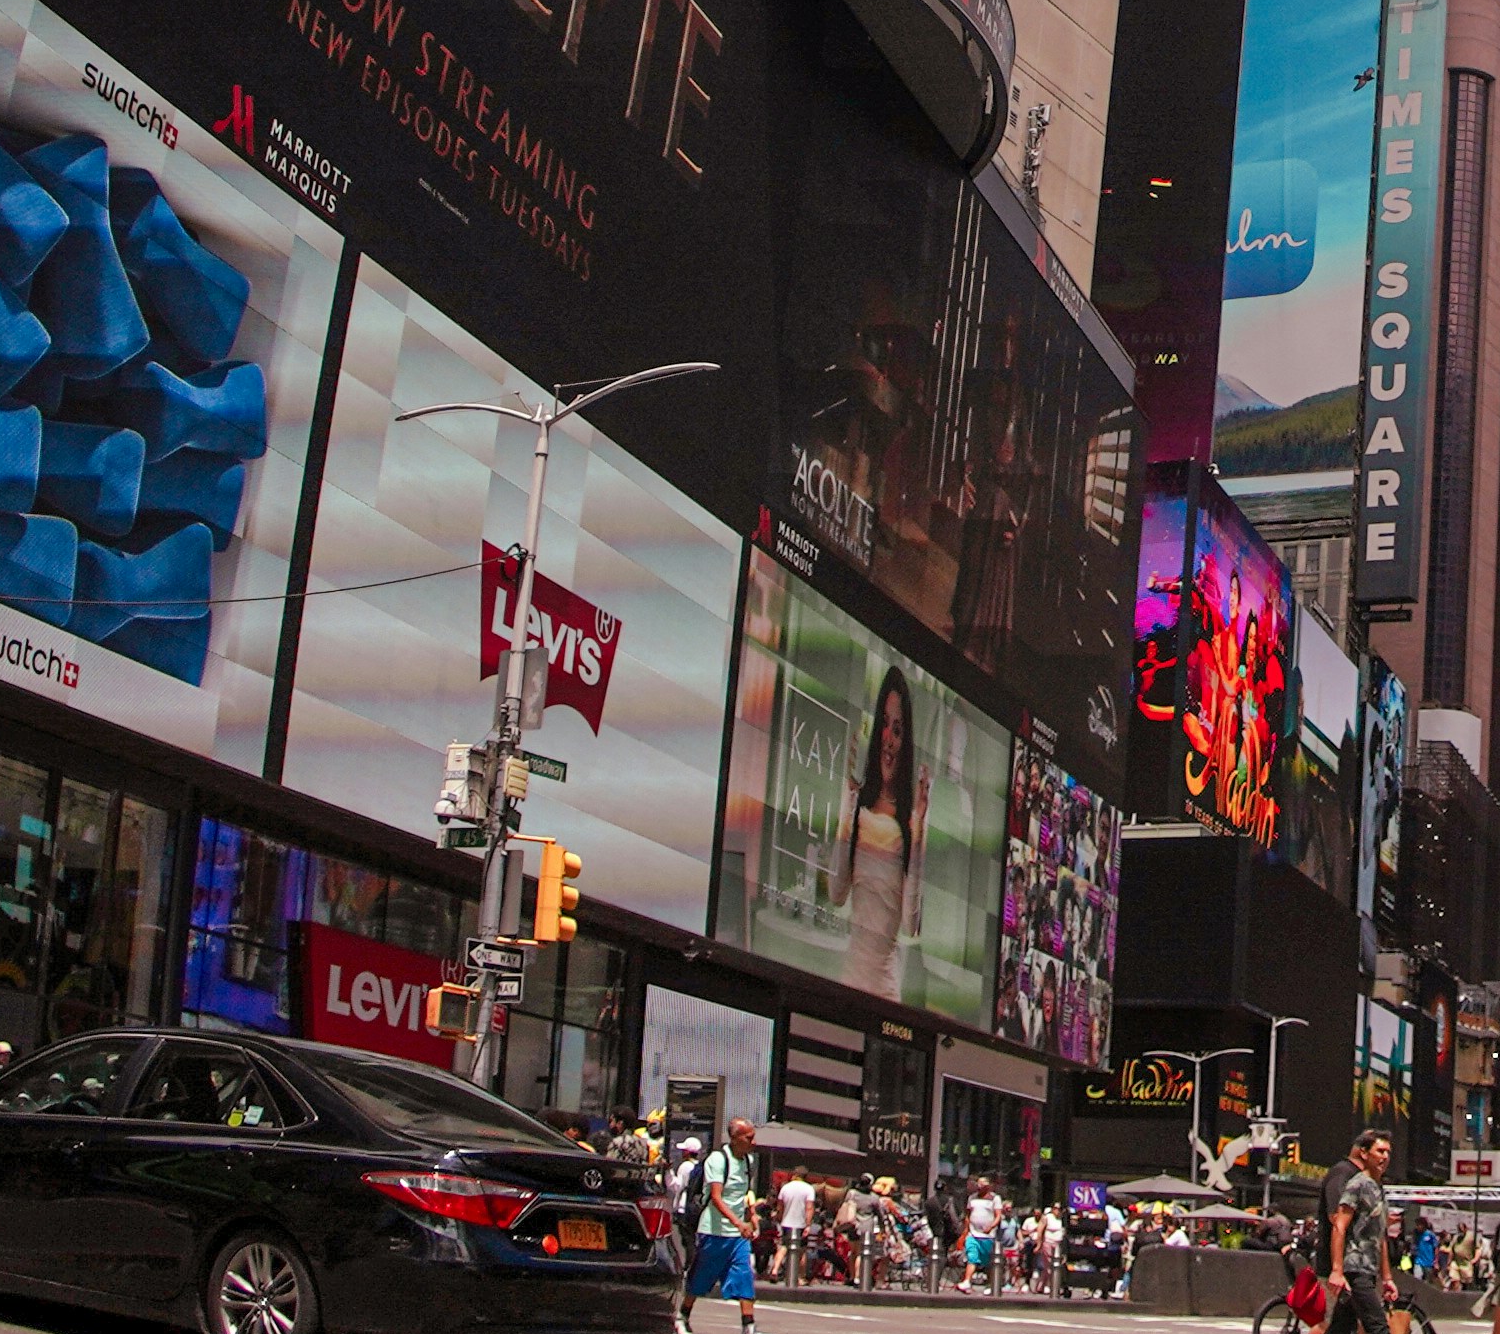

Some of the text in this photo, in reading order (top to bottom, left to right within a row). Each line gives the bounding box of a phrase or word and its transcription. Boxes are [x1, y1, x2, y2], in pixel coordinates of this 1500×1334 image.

[82, 62, 167, 144] swatch
[415, 30, 599, 231] STREAMING
[264, 146, 338, 214] MARQUIS
[270, 118, 352, 195] MARRIOTT
[359, 54, 479, 183] EPISODES
[490, 165, 592, 283] TUESDAYS
[1365, 2, 1422, 562] TIMES SQUARE
[791, 490, 871, 567] NOW STREAMING
[793, 448, 876, 547] ACOLYTE
[776, 539, 814, 578] MARQUIS
[778, 520, 820, 561] MARRIOTT
[530, 756, 562, 779] roadway
[790, 716, 842, 781] KAY
[464, 830, 477, 847] 45
[785, 784, 832, 843] ALI
[475, 949, 520, 968] ONE WAY
[326, 964, 441, 1037] Levi'
[881, 1020, 914, 1042] SEPHORA
[1086, 1058, 1194, 1101] Aladdin
[867, 1126, 926, 1159] SEPHORA
